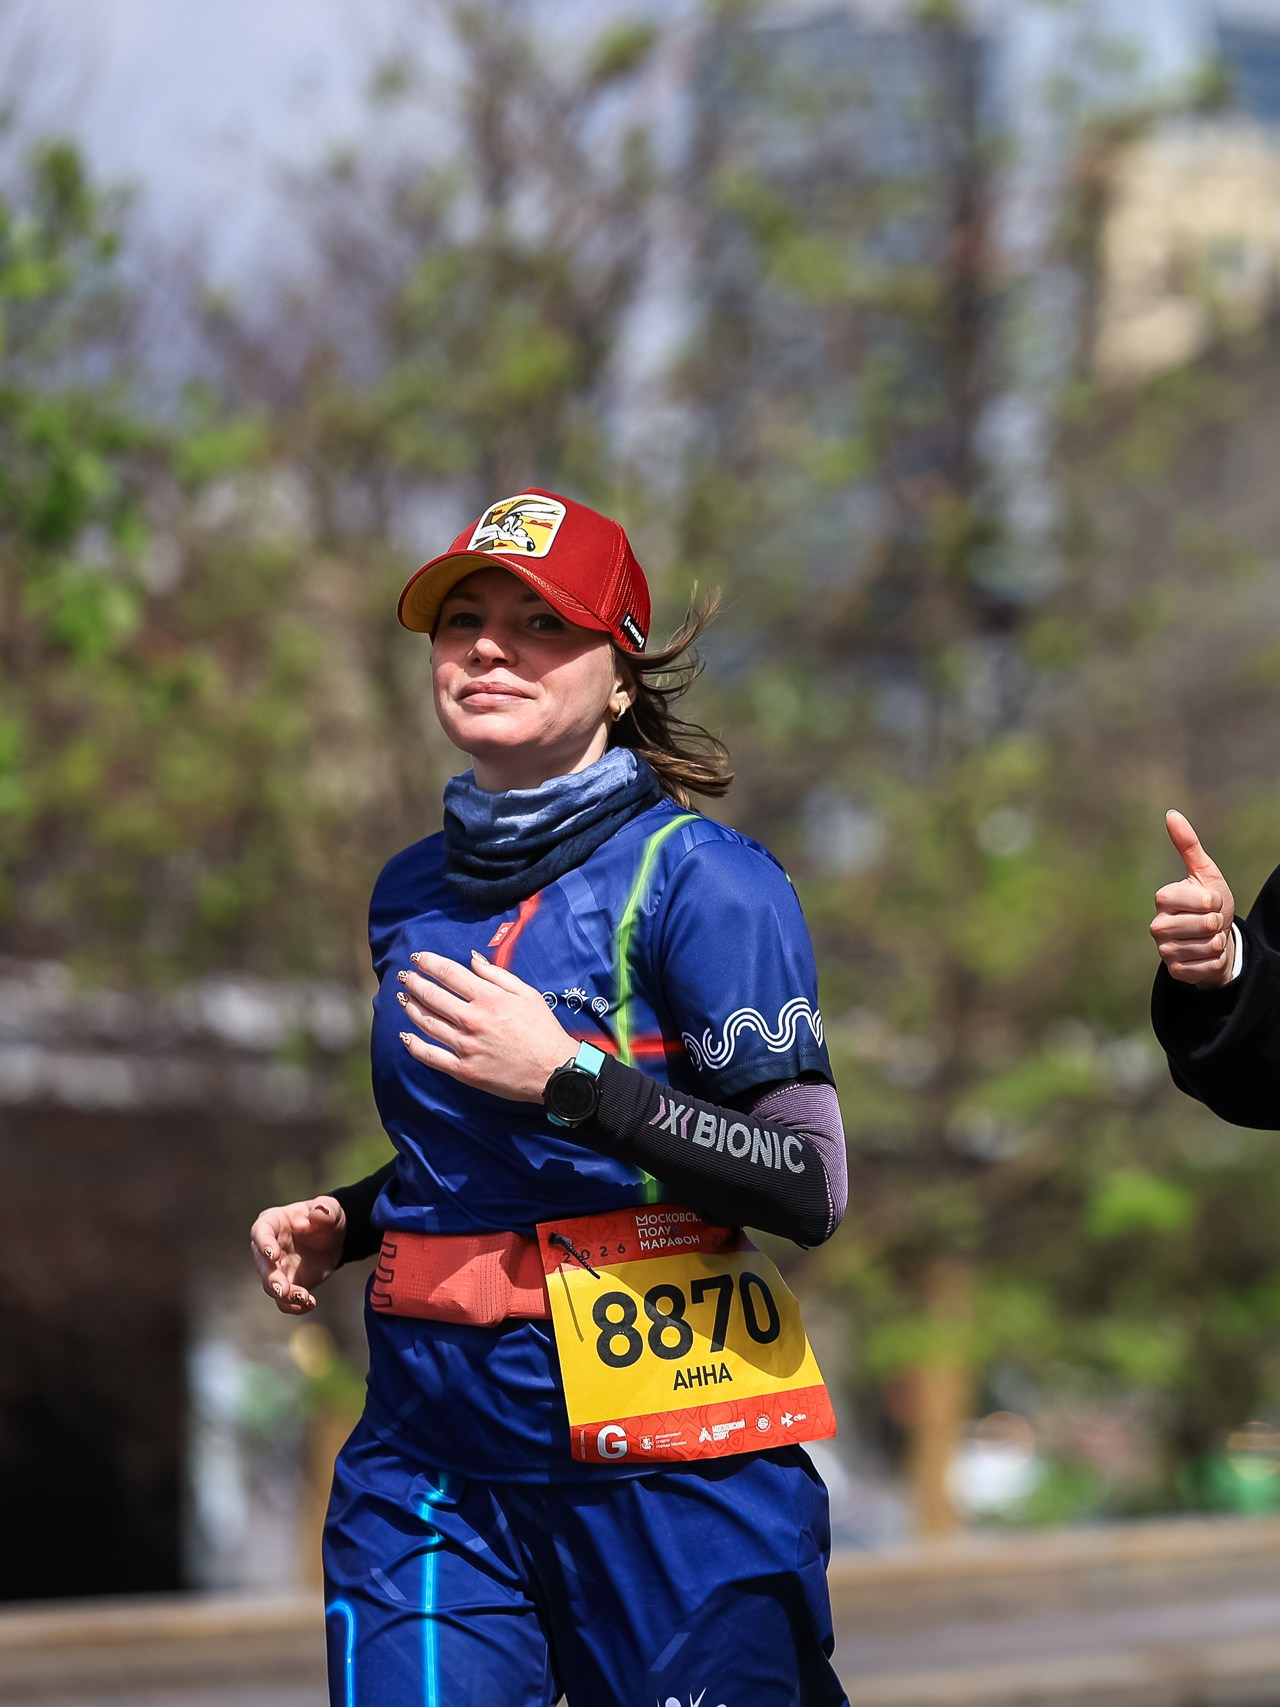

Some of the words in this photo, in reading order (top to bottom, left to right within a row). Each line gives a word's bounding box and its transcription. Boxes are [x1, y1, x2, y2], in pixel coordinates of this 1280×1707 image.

[692, 1110, 806, 1174] BIONIC
[635, 1212, 702, 1227] МОСКОВСК
[638, 1226, 671, 1239] ПОЛУ
[640, 1235, 700, 1251] МАРАФОН
[592, 1271, 781, 1368] 8870
[673, 1362, 733, 1391] АННА
[597, 1424, 628, 1459] G
